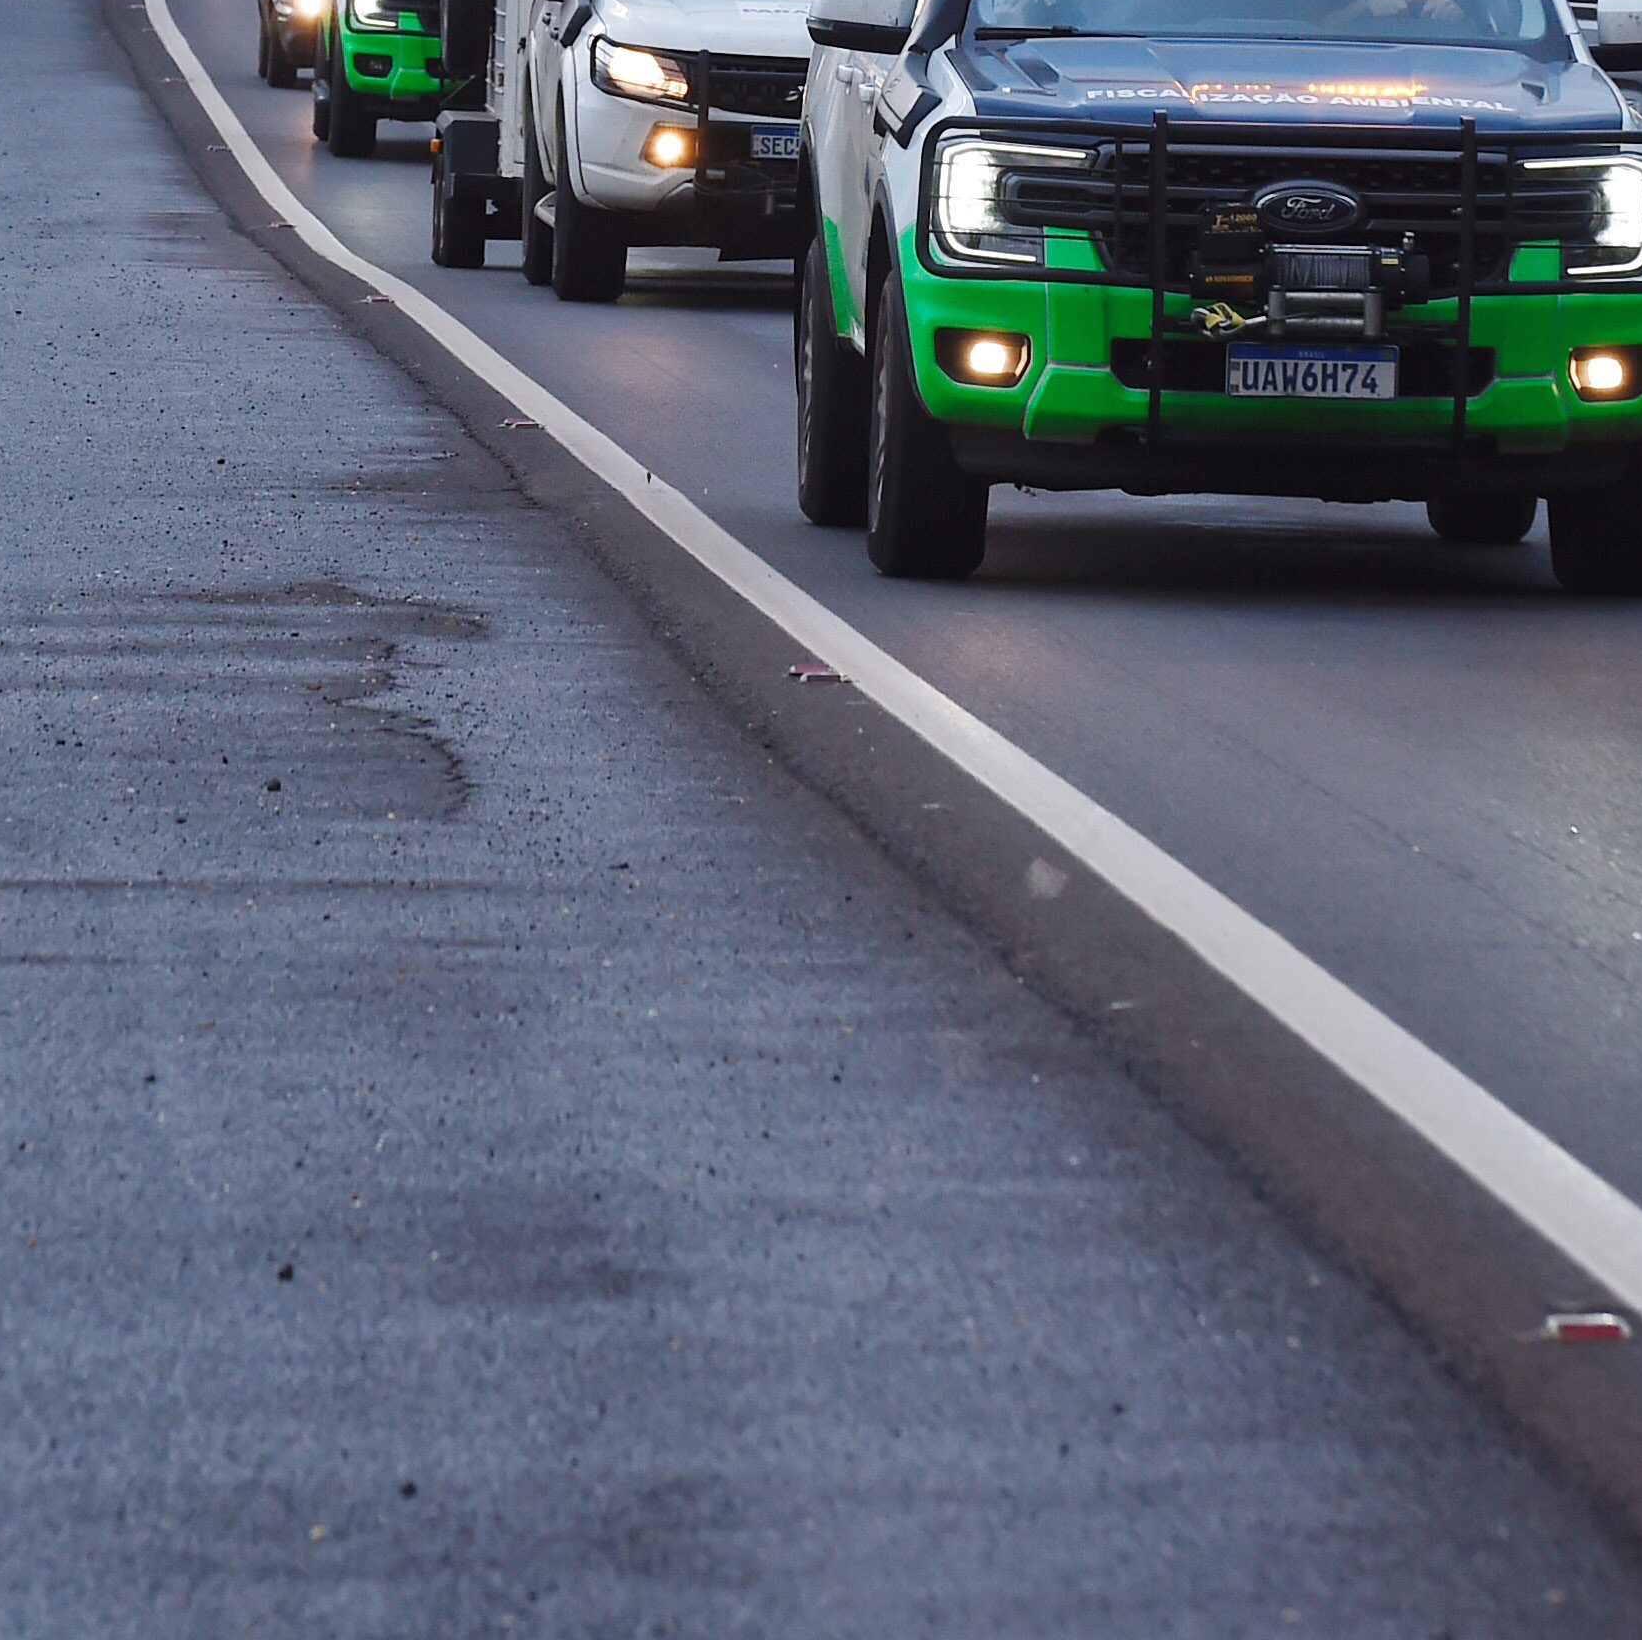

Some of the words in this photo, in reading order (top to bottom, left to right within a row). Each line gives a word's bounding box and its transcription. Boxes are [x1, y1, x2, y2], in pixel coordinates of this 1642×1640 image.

[1329, 95, 1515, 112] AMBIENTAL
[1281, 196, 1336, 221] Ford
[1242, 361, 1378, 394] UAW6H74
